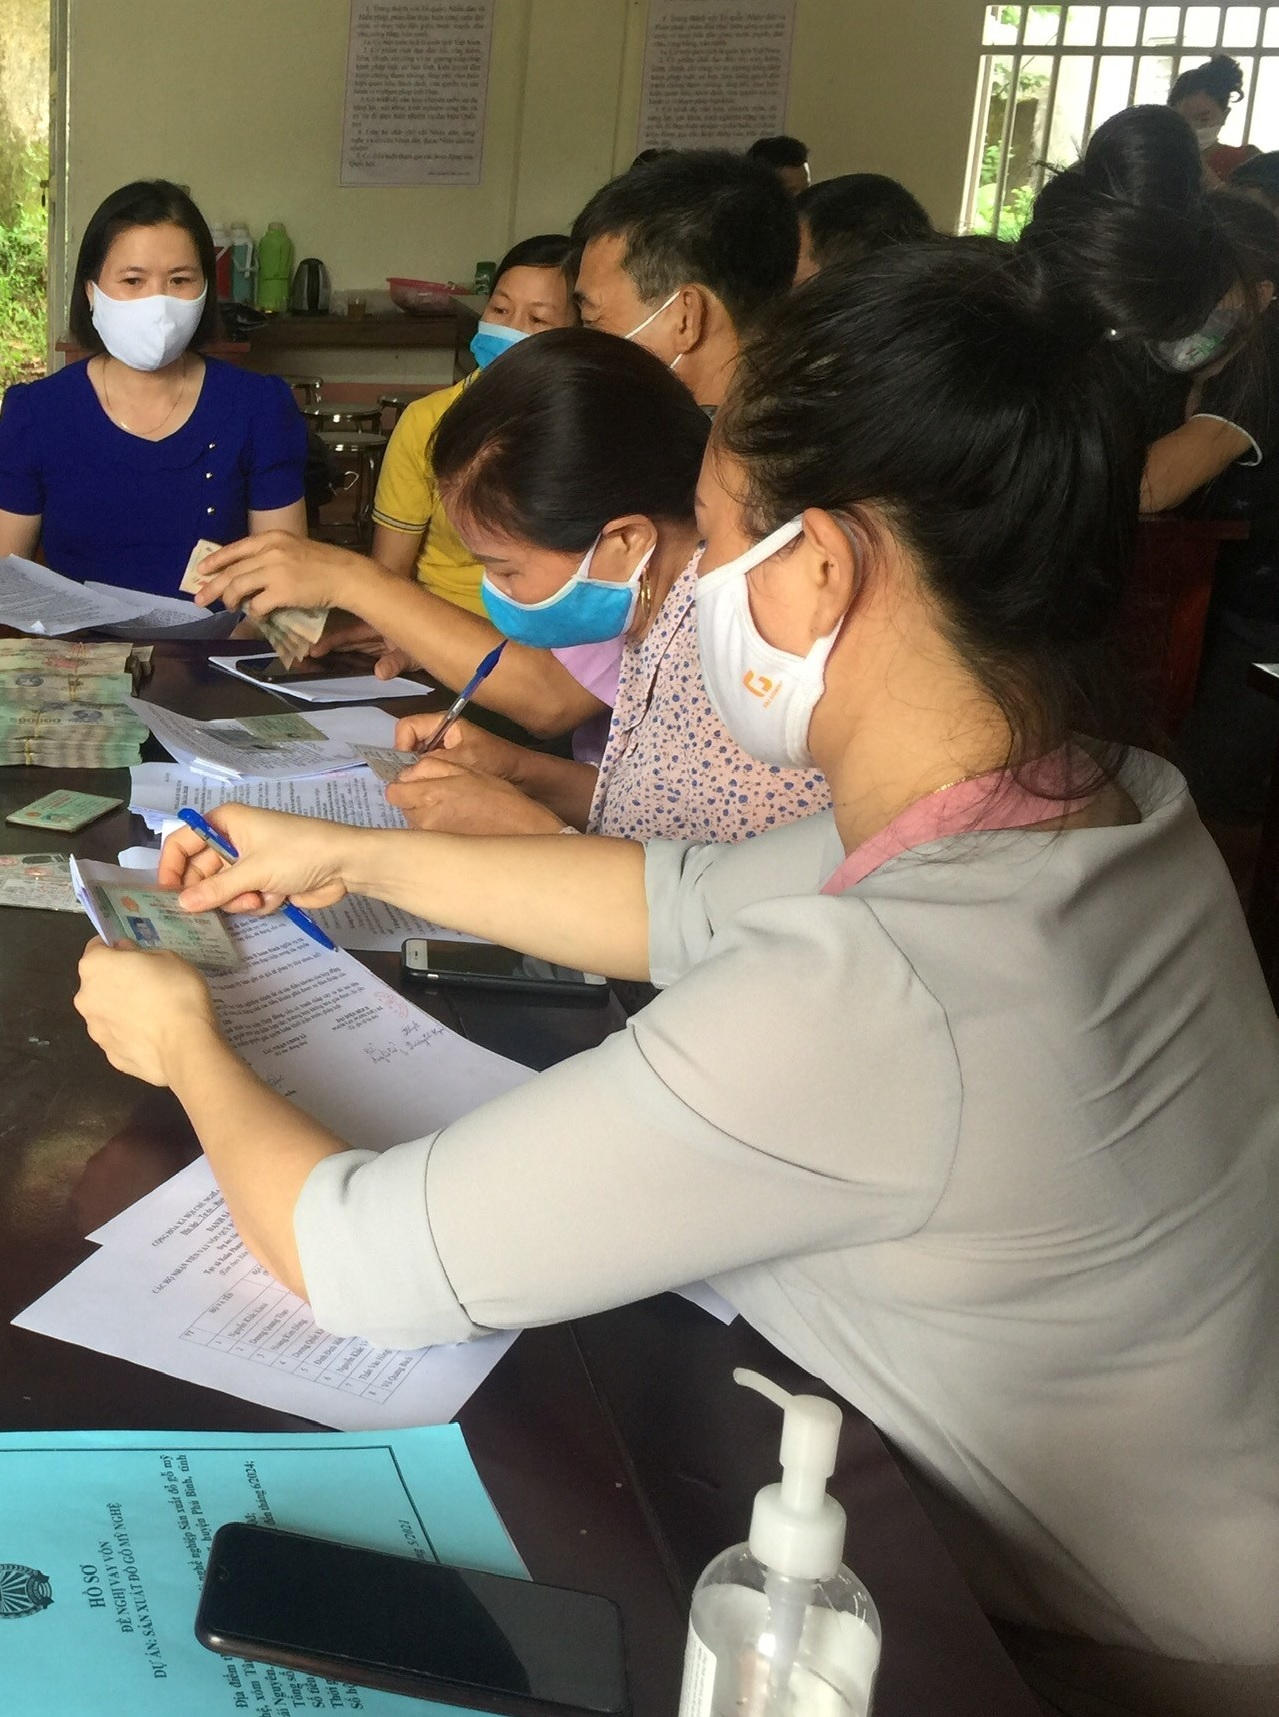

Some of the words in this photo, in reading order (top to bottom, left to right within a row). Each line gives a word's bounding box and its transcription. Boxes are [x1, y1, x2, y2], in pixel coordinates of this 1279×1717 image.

[160, 1454, 173, 1468] mỹ
[161, 1471, 178, 1482] gỗ
[168, 1497, 185, 1513] xuất
[189, 1500, 203, 1515] Phú
[255, 1490, 270, 1511] tháng
[106, 1503, 124, 1530] NGHỆ
[196, 1518, 214, 1541] huyện
[114, 1533, 129, 1547] MỸ
[183, 1532, 202, 1558] nghiệp
[98, 1541, 114, 1562] VỐN
[79, 1565, 100, 1583] SƠ
[105, 1564, 120, 1586] VAY
[123, 1566, 140, 1581] ĐỒ
[82, 1587, 106, 1608] HỒ
[111, 1588, 129, 1615] NGHỊ
[116, 1617, 134, 1633] ĐỀ
[145, 1639, 160, 1657] ÁN:
[149, 1656, 167, 1678] DỰ
[223, 1664, 242, 1688] điểm
[279, 1666, 297, 1681] số
[251, 1681, 265, 1701] xóm
[265, 1665, 286, 1705] Nguyên.
[301, 1674, 320, 1694] tiền
[233, 1691, 249, 1708] Địa
[287, 1683, 306, 1708] Tổng
[306, 1692, 325, 1708] Số
[326, 1687, 344, 1709] Thời
[344, 1692, 364, 1709] Số
